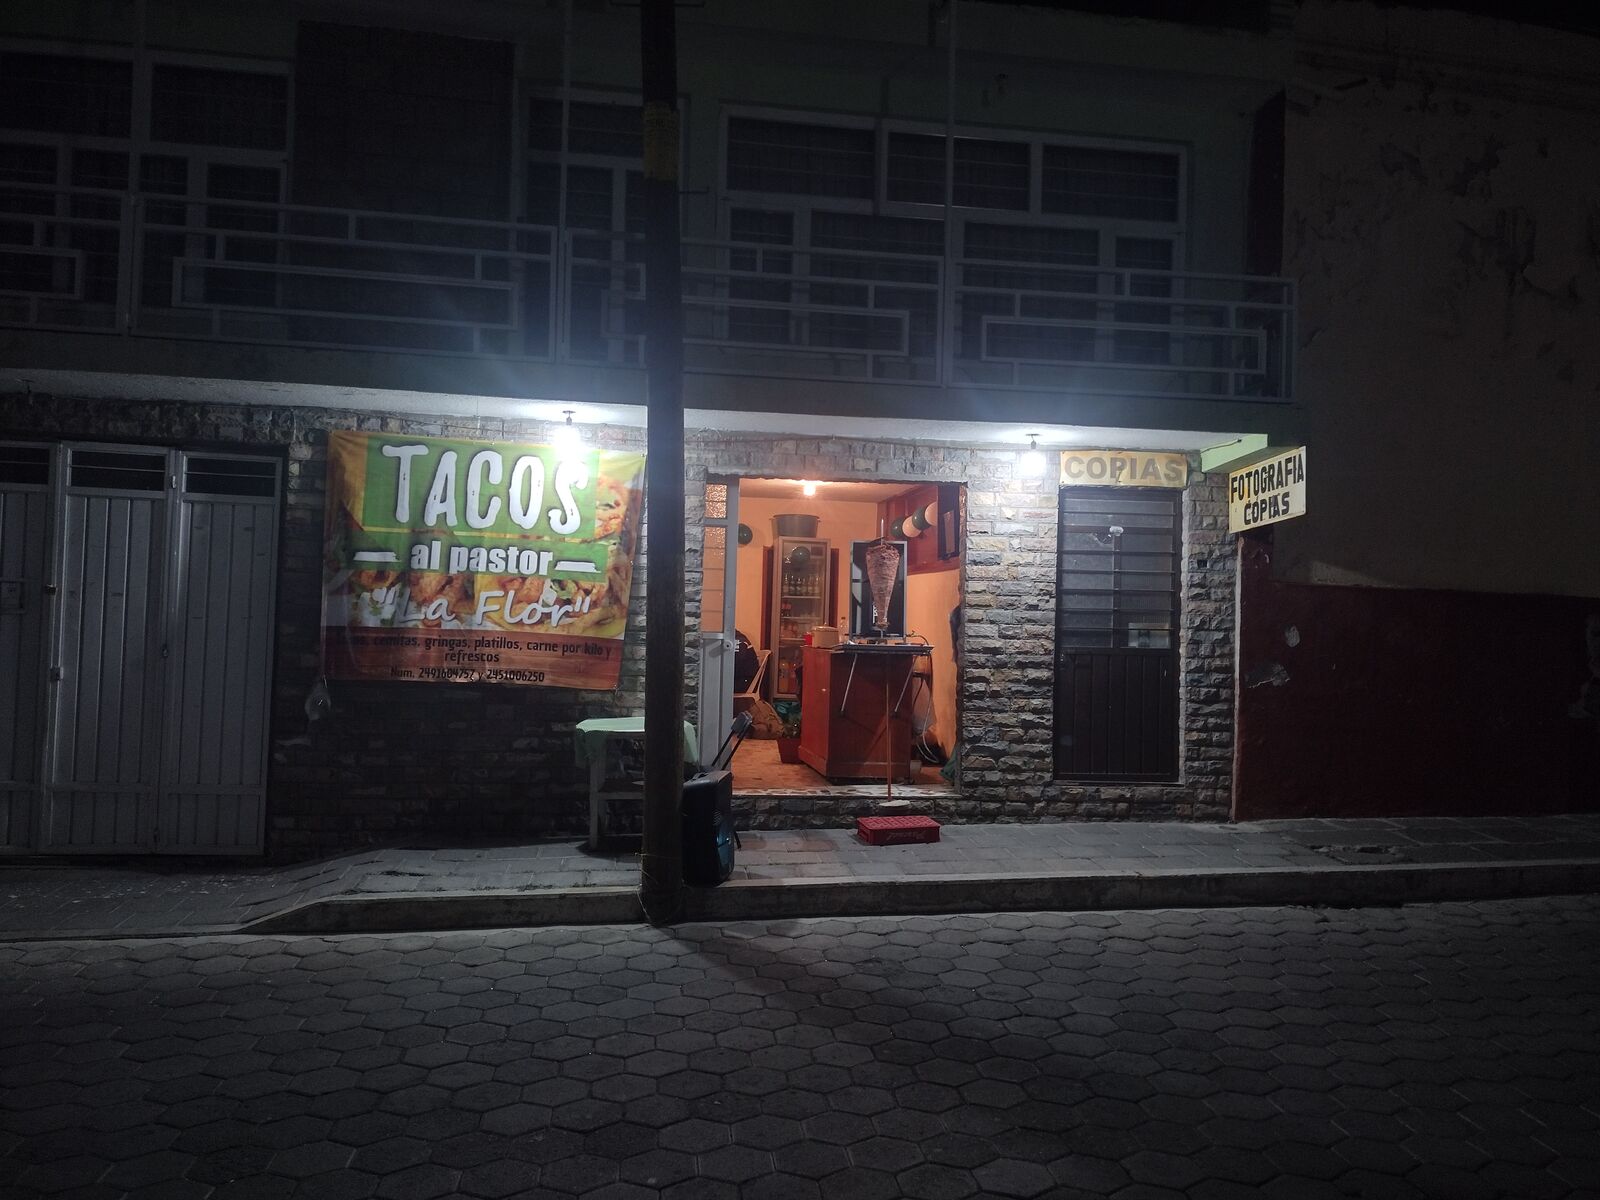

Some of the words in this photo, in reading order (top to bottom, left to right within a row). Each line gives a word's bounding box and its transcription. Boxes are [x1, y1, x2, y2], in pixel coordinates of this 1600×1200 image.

[1064, 456, 1184, 482] COPIAS
[1230, 453, 1304, 504] FOTOGRAFIA
[382, 444, 589, 535] TACOS
[1243, 492, 1291, 526] COPIAS
[411, 540, 442, 570] al
[448, 545, 553, 577] pastor
[425, 634, 471, 651] gringas,
[474, 636, 523, 651] platillos,
[527, 640, 559, 653] carne
[562, 643, 581, 657] por
[584, 642, 603, 656] kilo
[606, 646, 612, 661] y
[445, 650, 500, 664] refrescos
[486, 669, 545, 682] 2451006250
